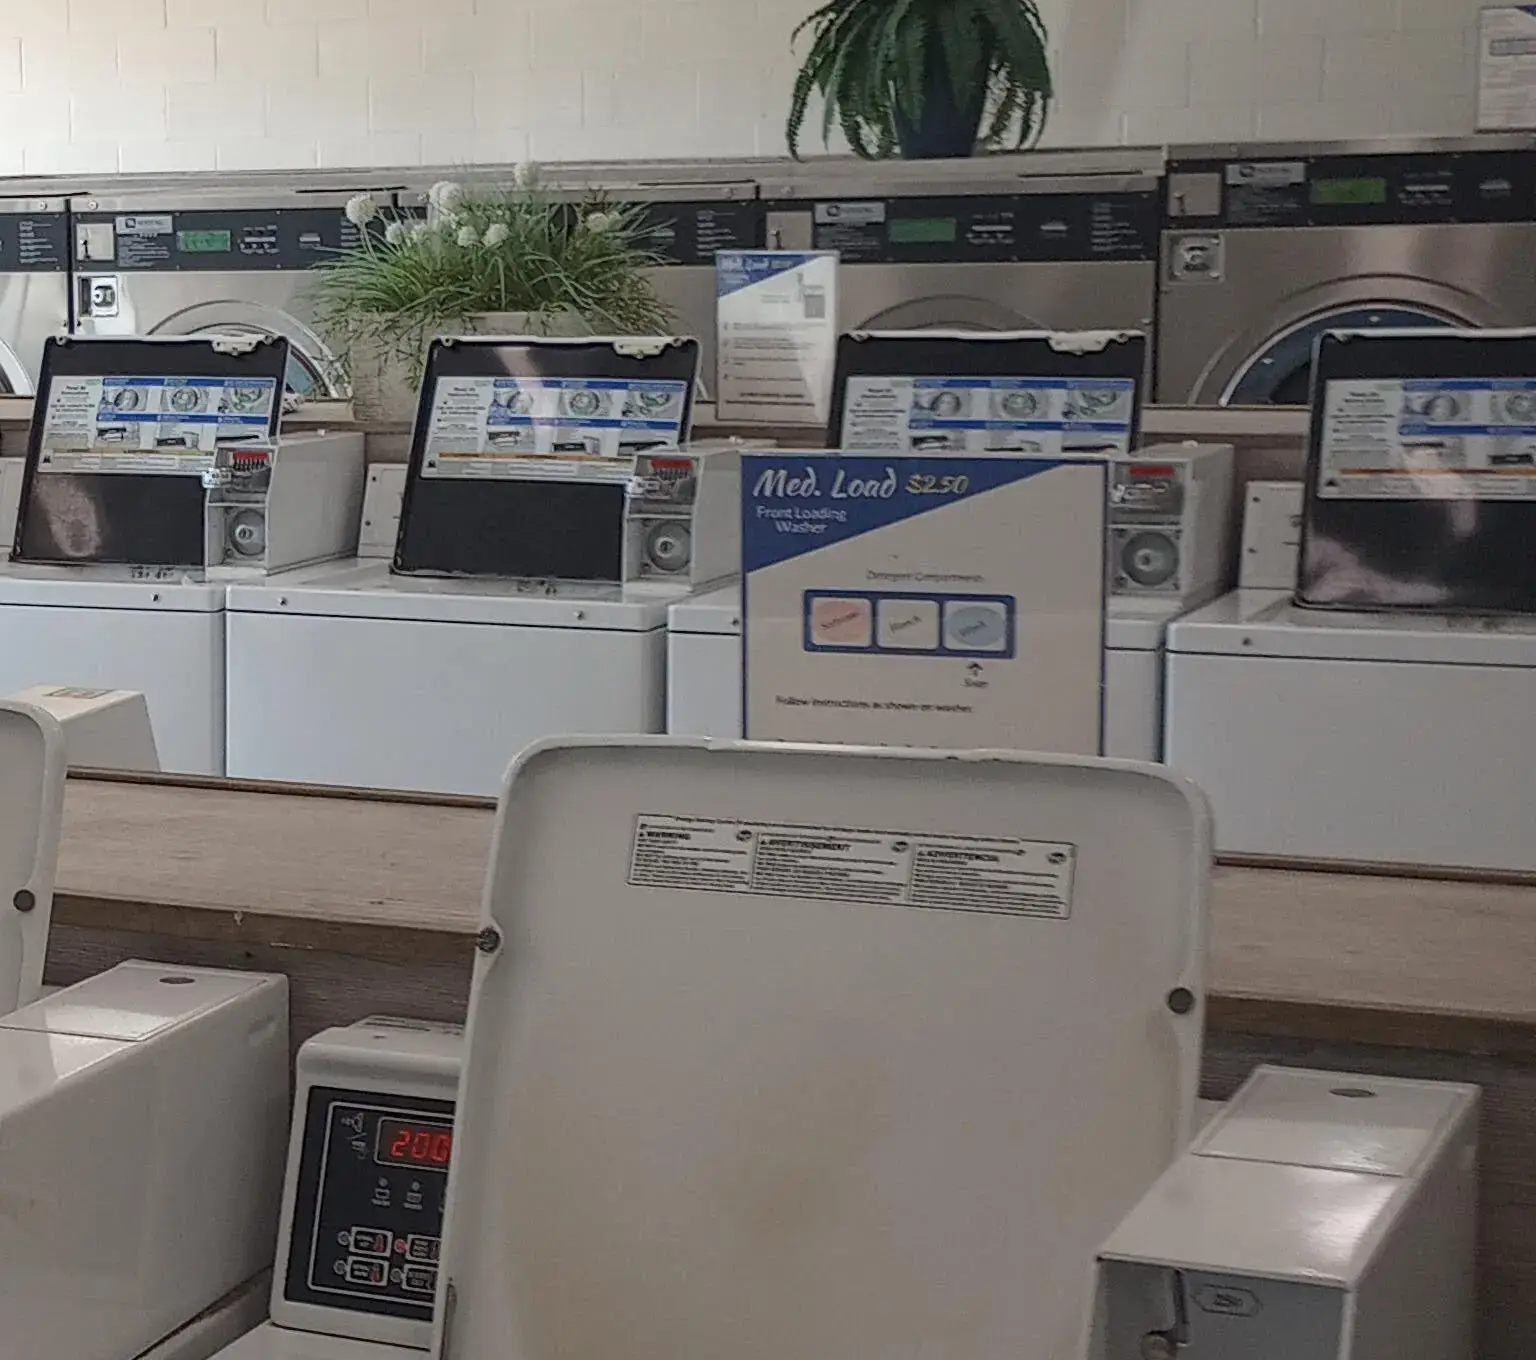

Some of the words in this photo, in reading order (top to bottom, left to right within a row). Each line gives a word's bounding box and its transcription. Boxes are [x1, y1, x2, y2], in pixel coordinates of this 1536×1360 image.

[752, 467, 822, 498] Med.
[830, 466, 896, 499] Load
[905, 473, 969, 495] $2.50
[774, 520, 827, 534] Washer
